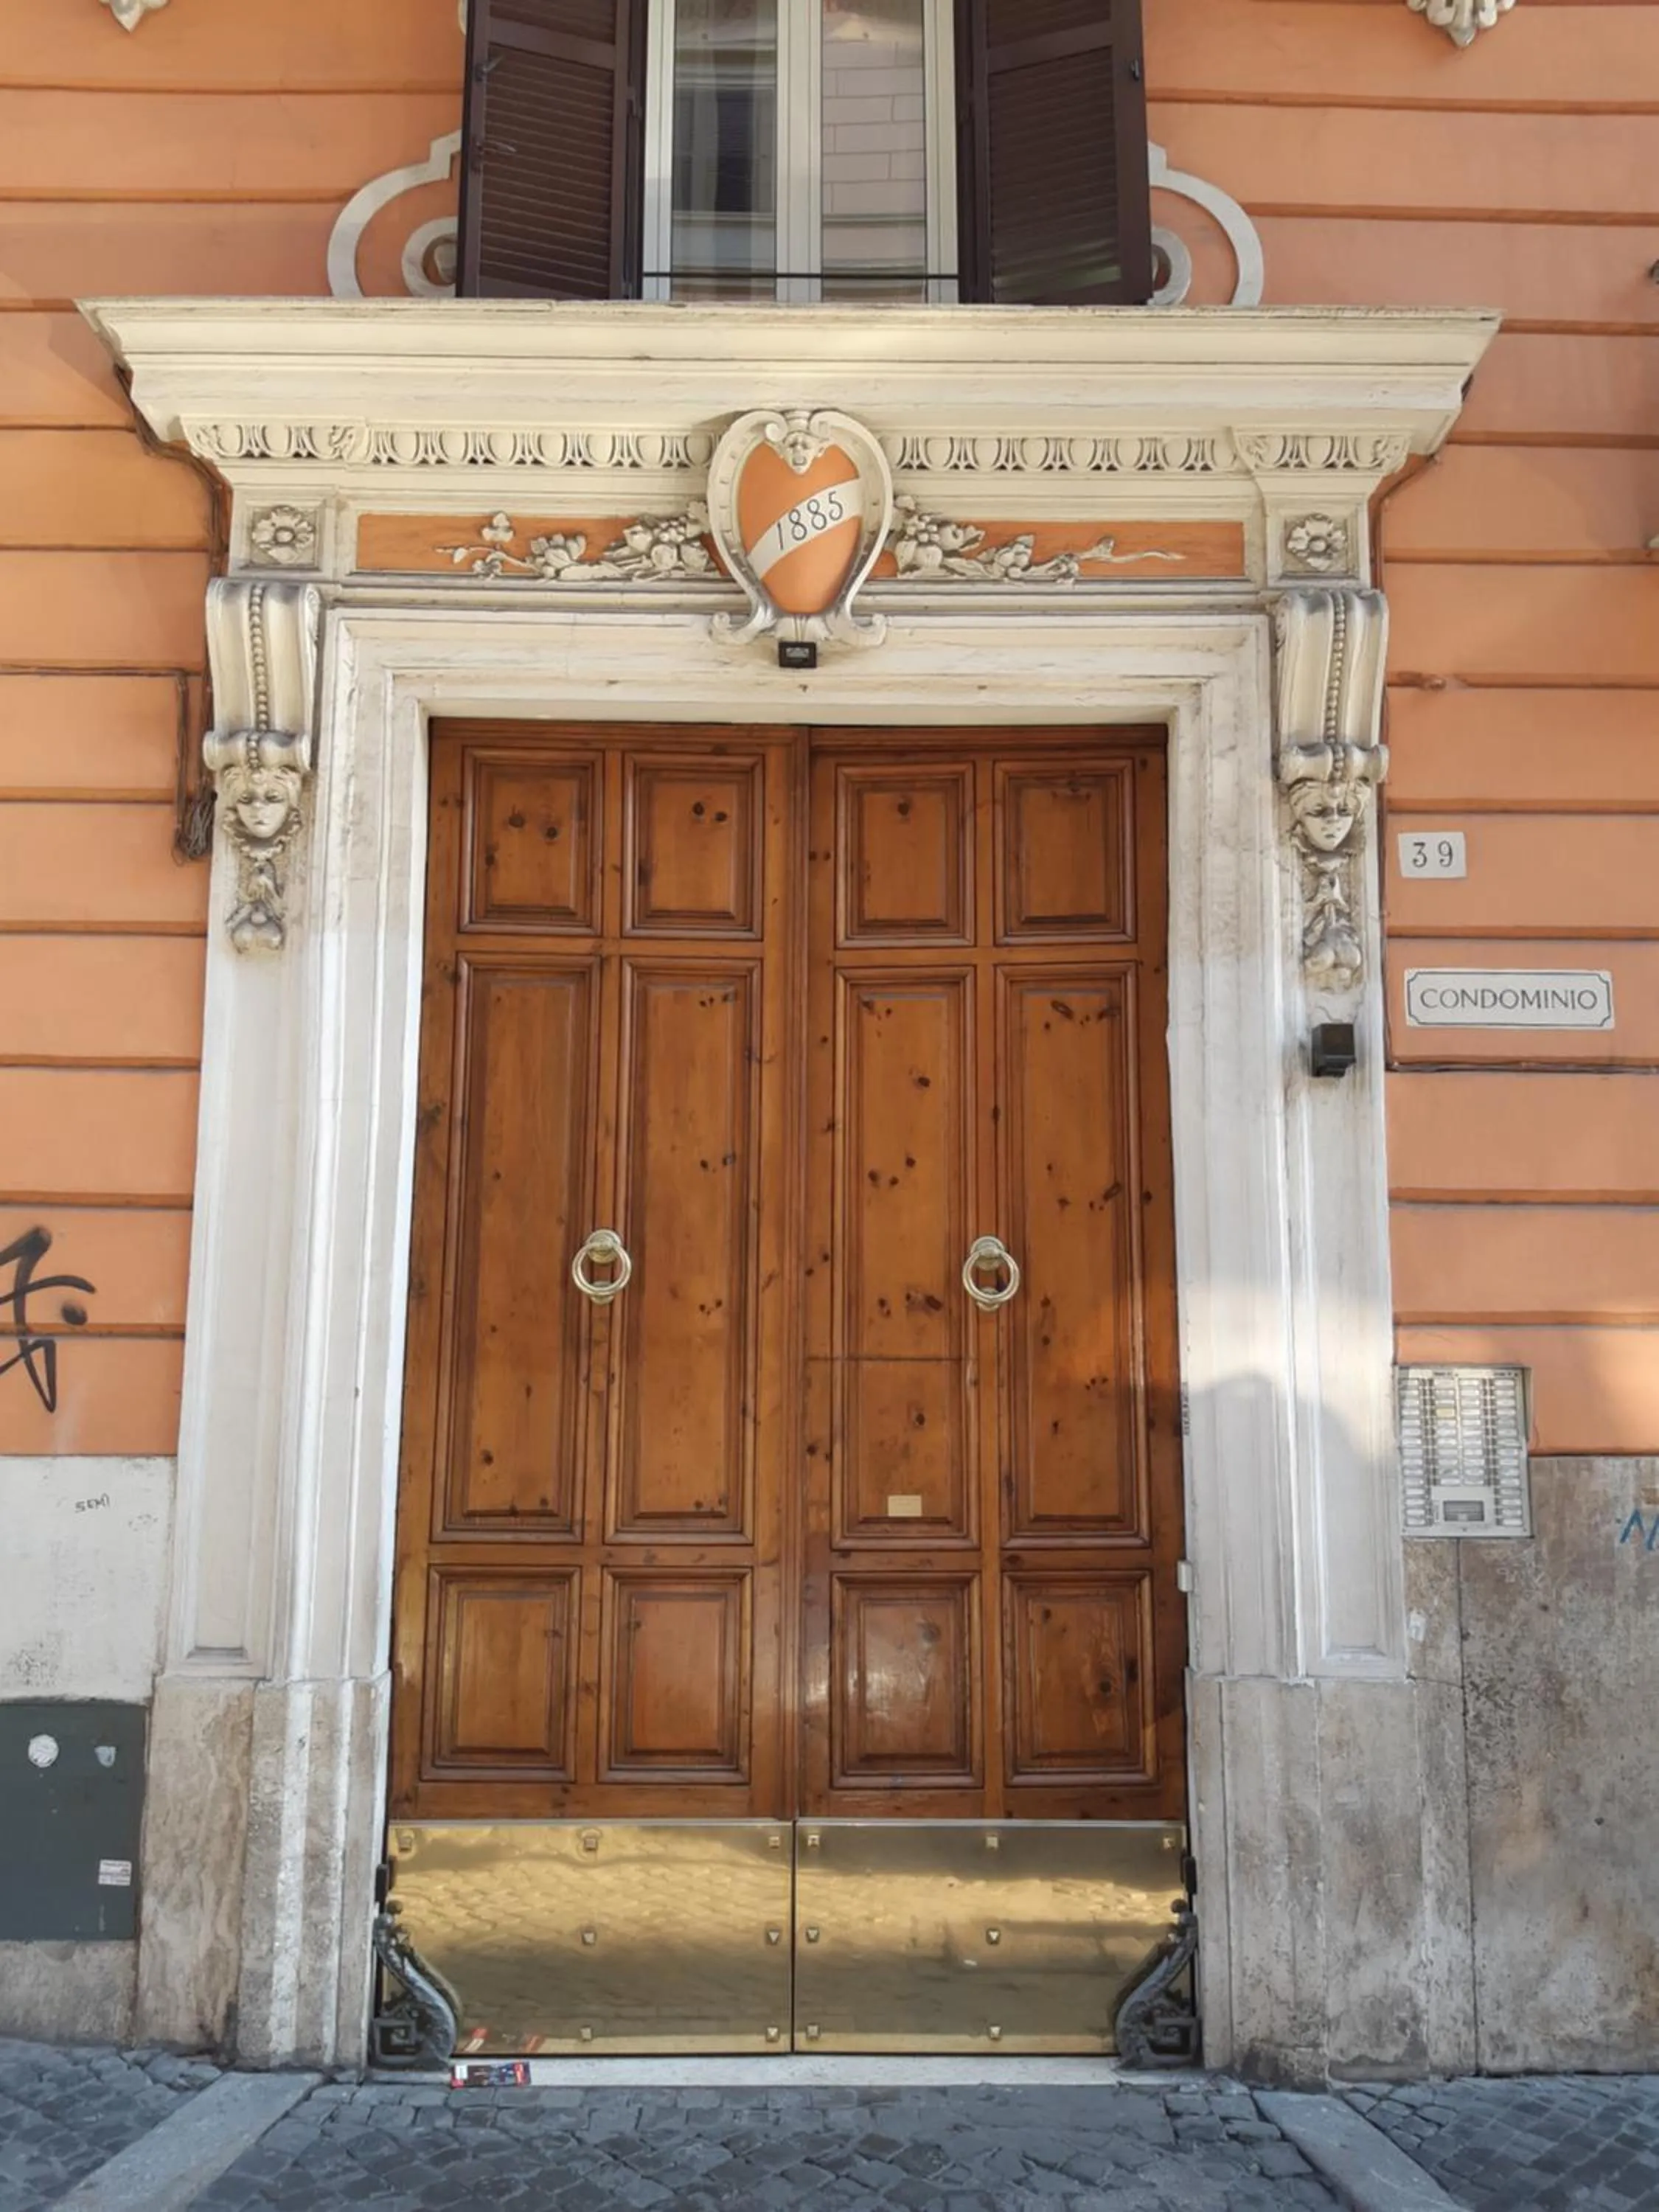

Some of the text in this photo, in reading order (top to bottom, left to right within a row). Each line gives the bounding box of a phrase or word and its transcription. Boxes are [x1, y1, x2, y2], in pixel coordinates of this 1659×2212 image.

[777, 490, 844, 551] 1885
[1412, 841, 1453, 868] 39
[1420, 989, 1598, 1009] CONDOMINIO
